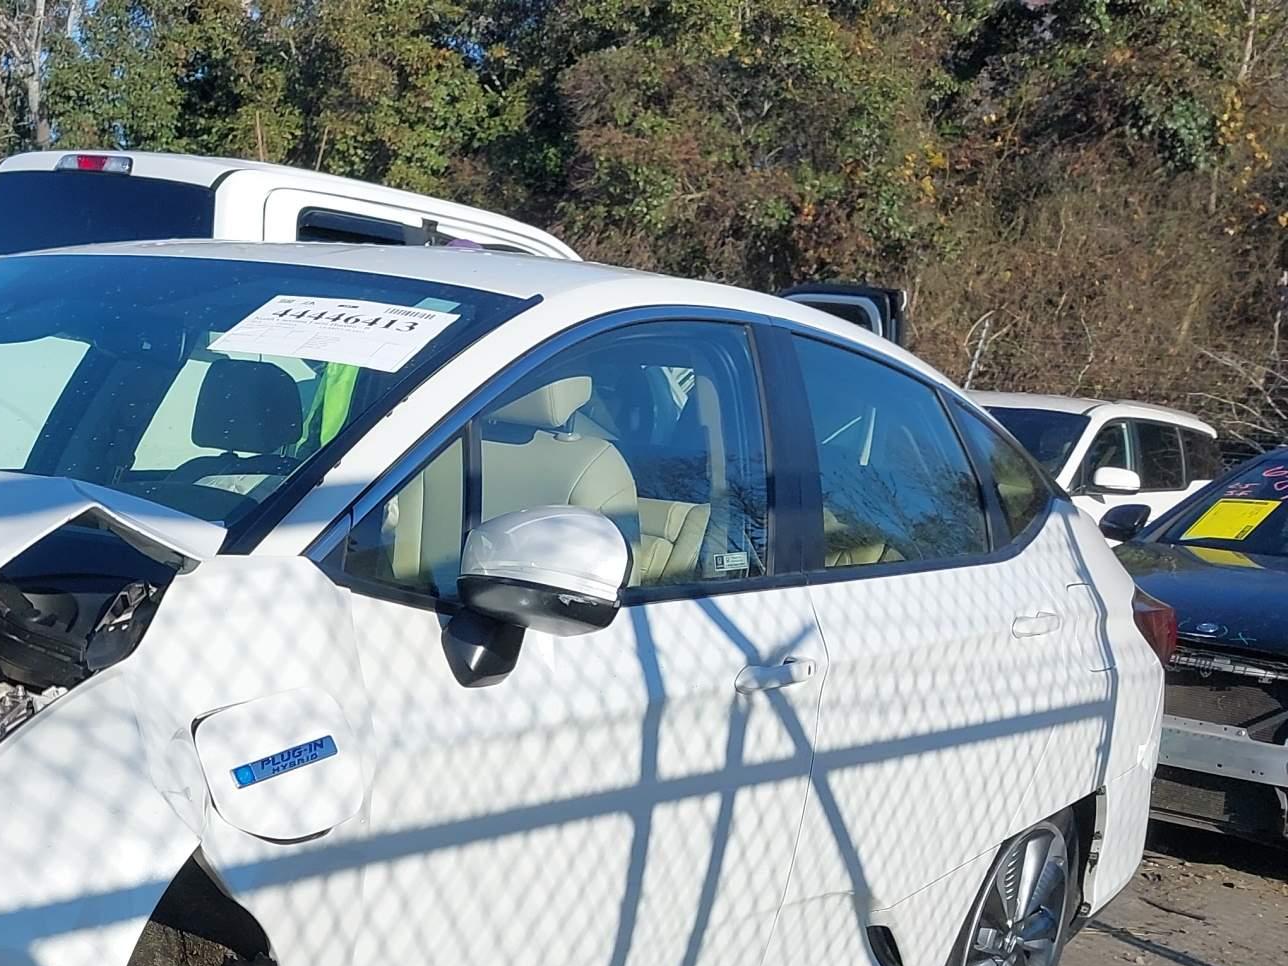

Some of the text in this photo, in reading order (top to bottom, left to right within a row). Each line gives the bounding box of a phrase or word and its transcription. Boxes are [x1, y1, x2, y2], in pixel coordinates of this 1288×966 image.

[272, 308, 419, 332] 44446413
[260, 739, 324, 770] PLUG-IN
[272, 752, 318, 774] HYBRID
